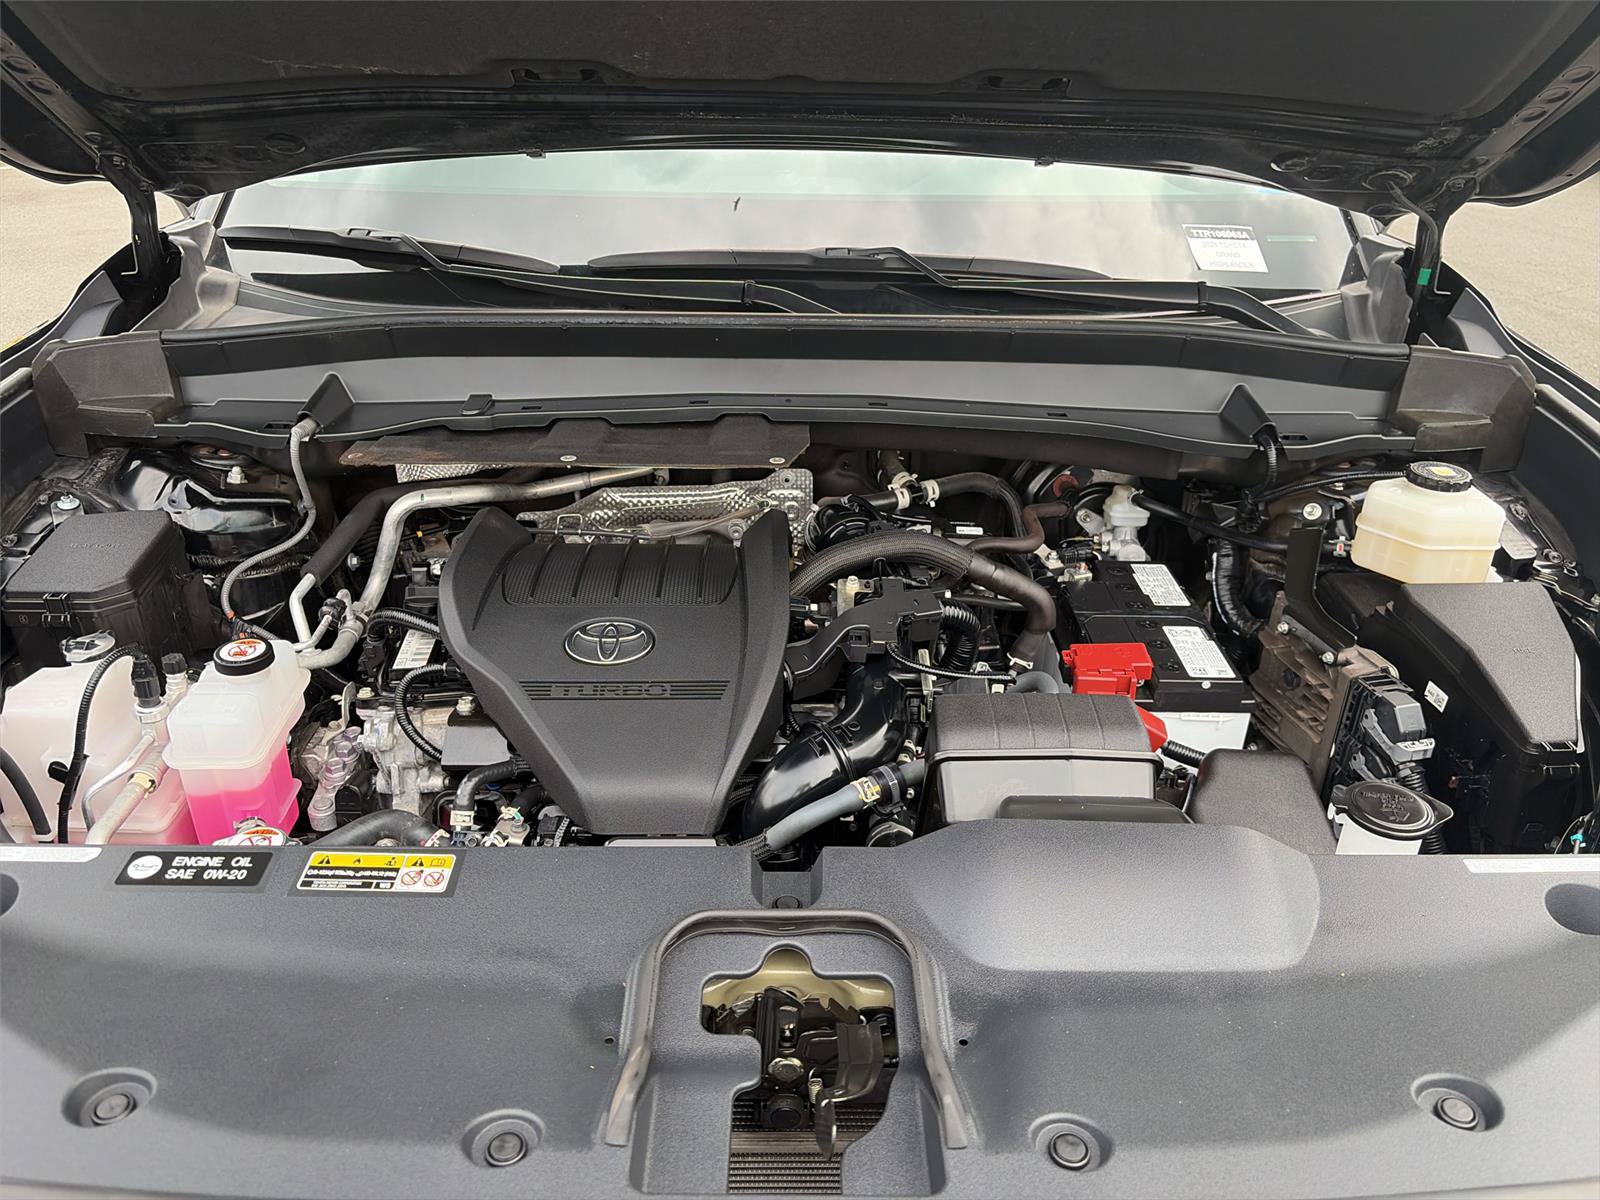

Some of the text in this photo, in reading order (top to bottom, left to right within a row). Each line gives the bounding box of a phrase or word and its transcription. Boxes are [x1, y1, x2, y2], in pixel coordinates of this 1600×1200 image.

[552, 683, 669, 697] TURBO
[172, 856, 253, 867] ENGINE OIL
[164, 868, 195, 880] SAE
[203, 869, 248, 880] 0W-20
